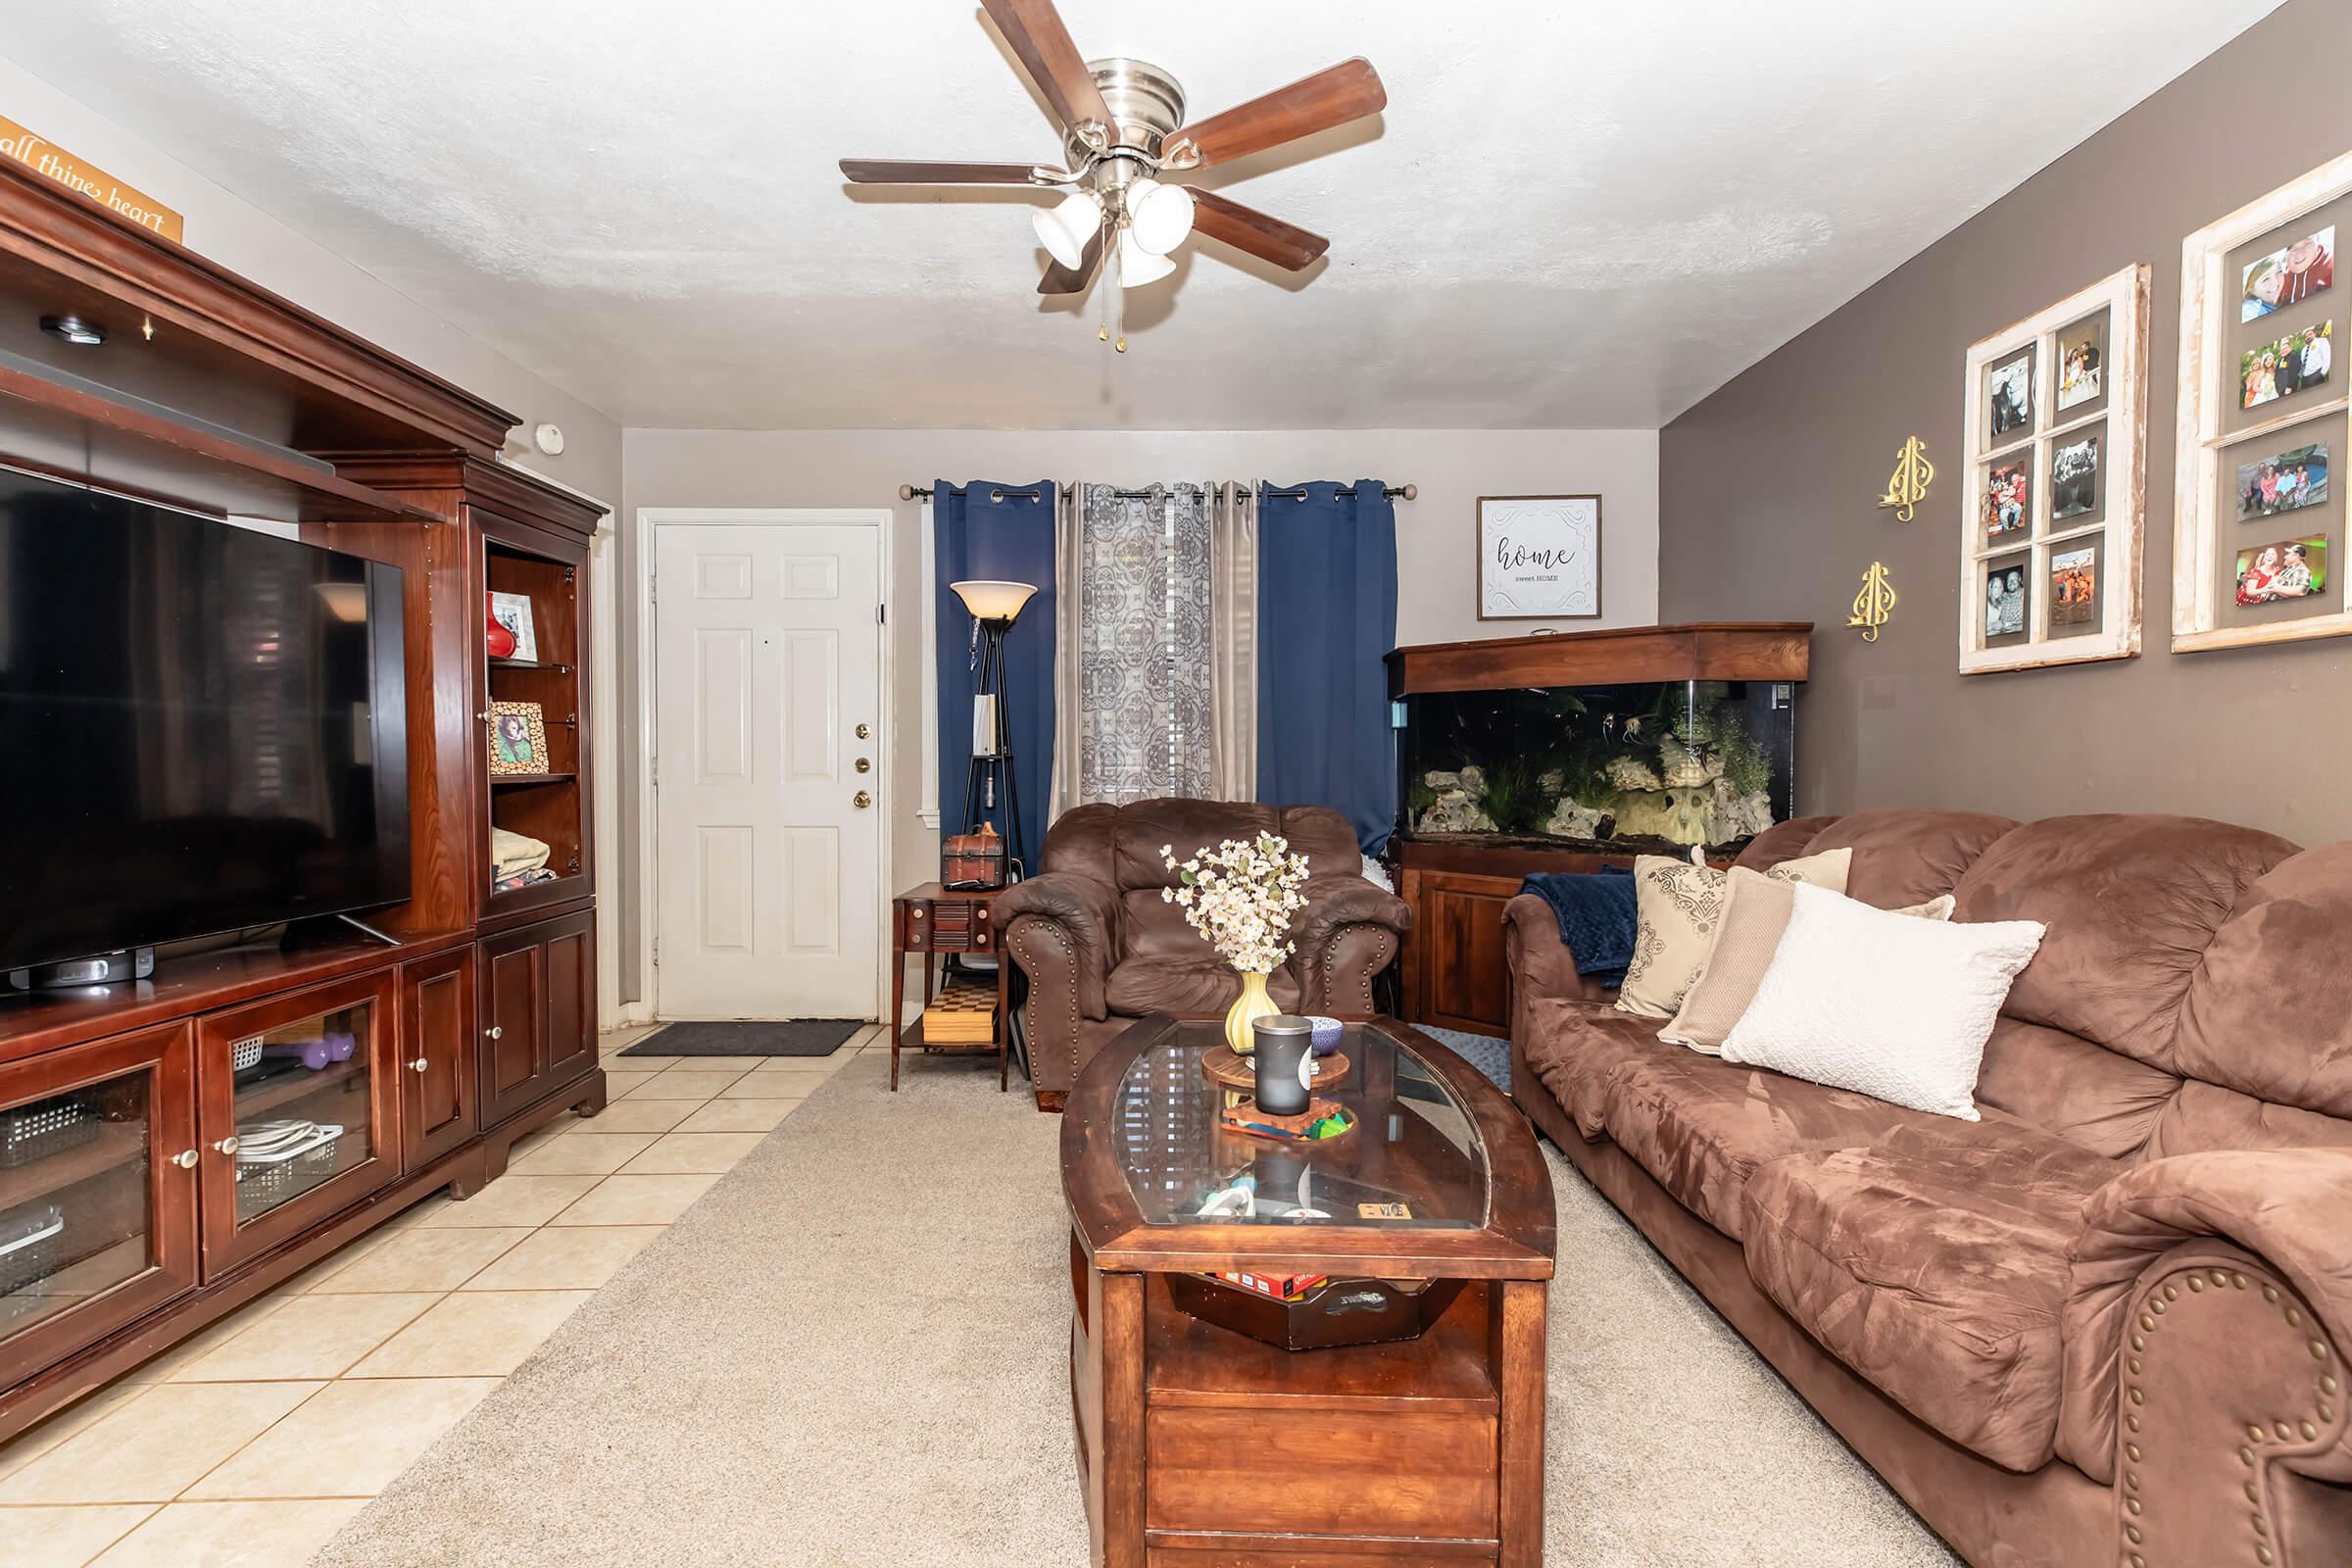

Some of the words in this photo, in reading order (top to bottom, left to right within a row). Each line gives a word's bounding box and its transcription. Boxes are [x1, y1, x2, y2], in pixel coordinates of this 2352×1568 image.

[0, 135, 46, 164] all
[38, 153, 102, 197] thine
[108, 187, 165, 232] heart
[1497, 536, 1575, 570] home
